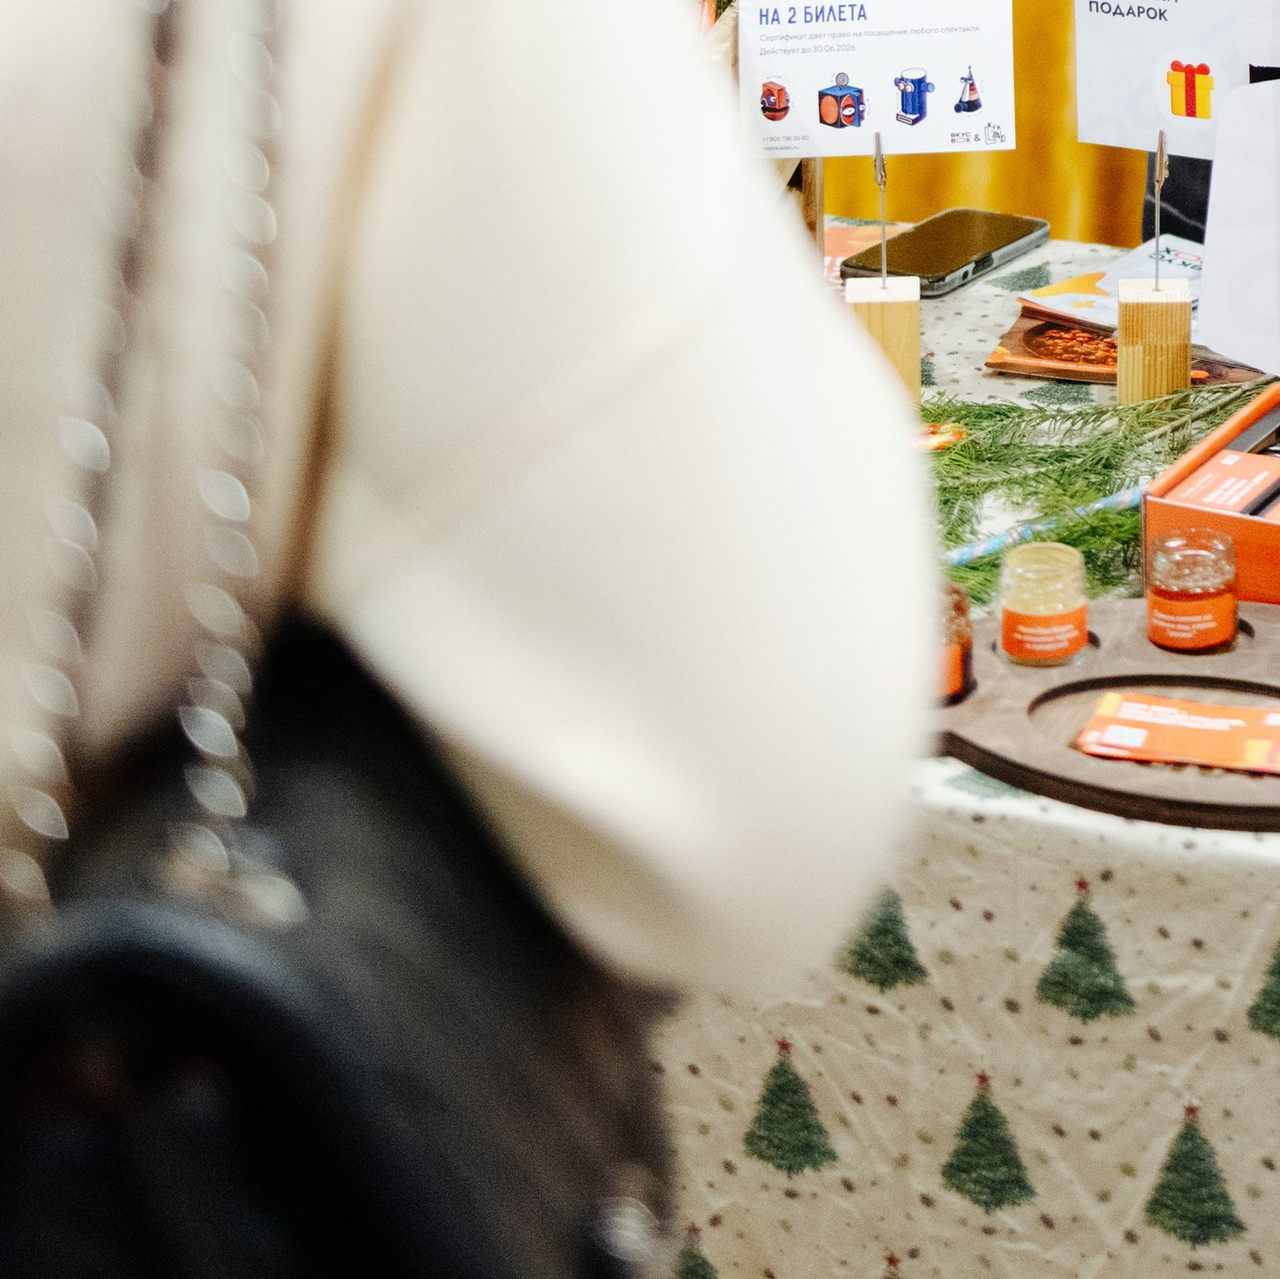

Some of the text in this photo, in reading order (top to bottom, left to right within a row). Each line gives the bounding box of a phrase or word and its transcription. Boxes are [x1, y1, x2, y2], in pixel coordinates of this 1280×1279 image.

[759, 3, 868, 25] НА 2 БИЛЕТА
[1089, 0, 1168, 21] ПОДАРОК
[759, 33, 807, 43] Сертификат
[808, 33, 827, 41] дает
[827, 31, 851, 41] право
[863, 29, 908, 38] посещение
[909, 27, 939, 36] любого
[940, 25, 980, 34] спектакля
[759, 47, 800, 56] Действует
[801, 46, 811, 54] до
